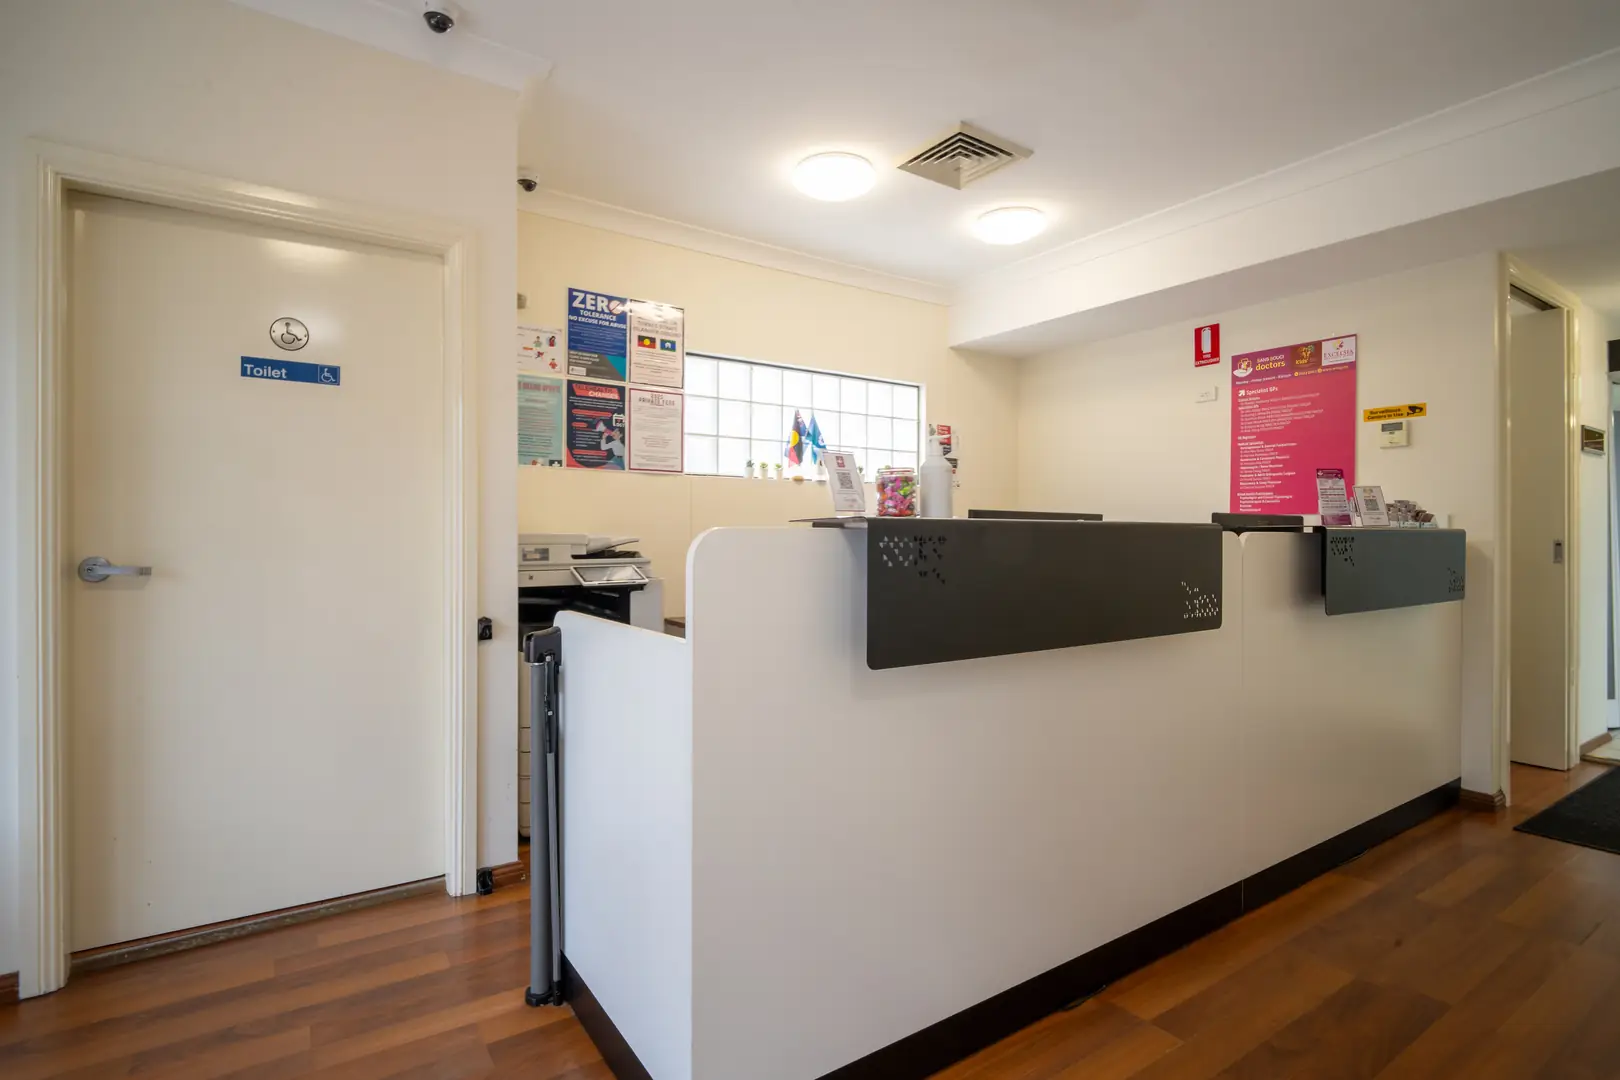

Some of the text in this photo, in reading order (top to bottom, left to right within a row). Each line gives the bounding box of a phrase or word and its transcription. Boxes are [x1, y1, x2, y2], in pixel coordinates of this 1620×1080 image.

[580, 309, 617, 322] TOLERANCE
[578, 316, 598, 325] EXCUSE
[598, 319, 610, 327] FOR
[610, 322, 627, 330] ABUSE
[243, 364, 288, 379] Toilet
[1255, 360, 1286, 371] doctors
[588, 390, 619, 400] CHANGES
[1246, 387, 1269, 396] Specialist
